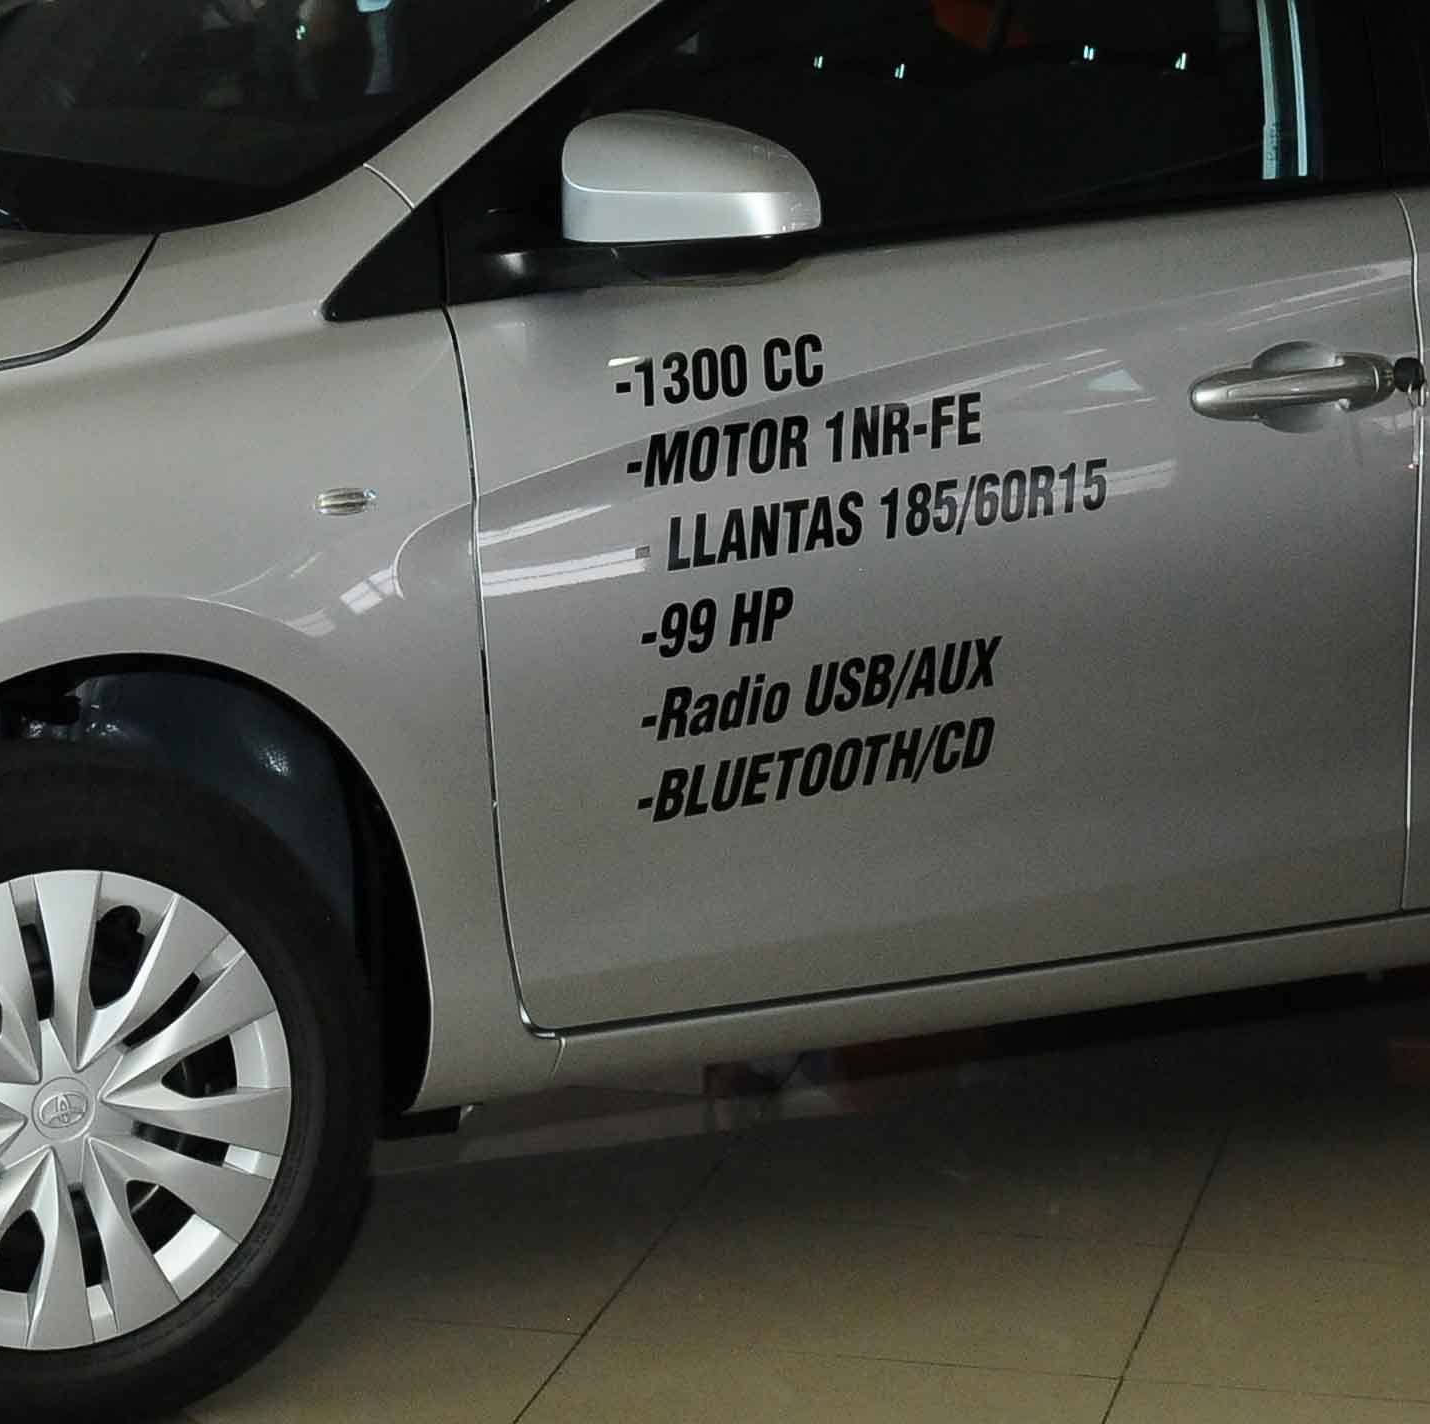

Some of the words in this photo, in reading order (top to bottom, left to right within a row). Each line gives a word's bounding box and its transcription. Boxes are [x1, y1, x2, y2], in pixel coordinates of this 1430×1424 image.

[764, 333, 824, 392] CC
[825, 391, 982, 463] 1NR-FE
[666, 490, 865, 572] LLANTAS
[879, 458, 1108, 539] 185/60R15
[728, 586, 794, 647] HP
[803, 635, 1002, 717] USB/AUX
